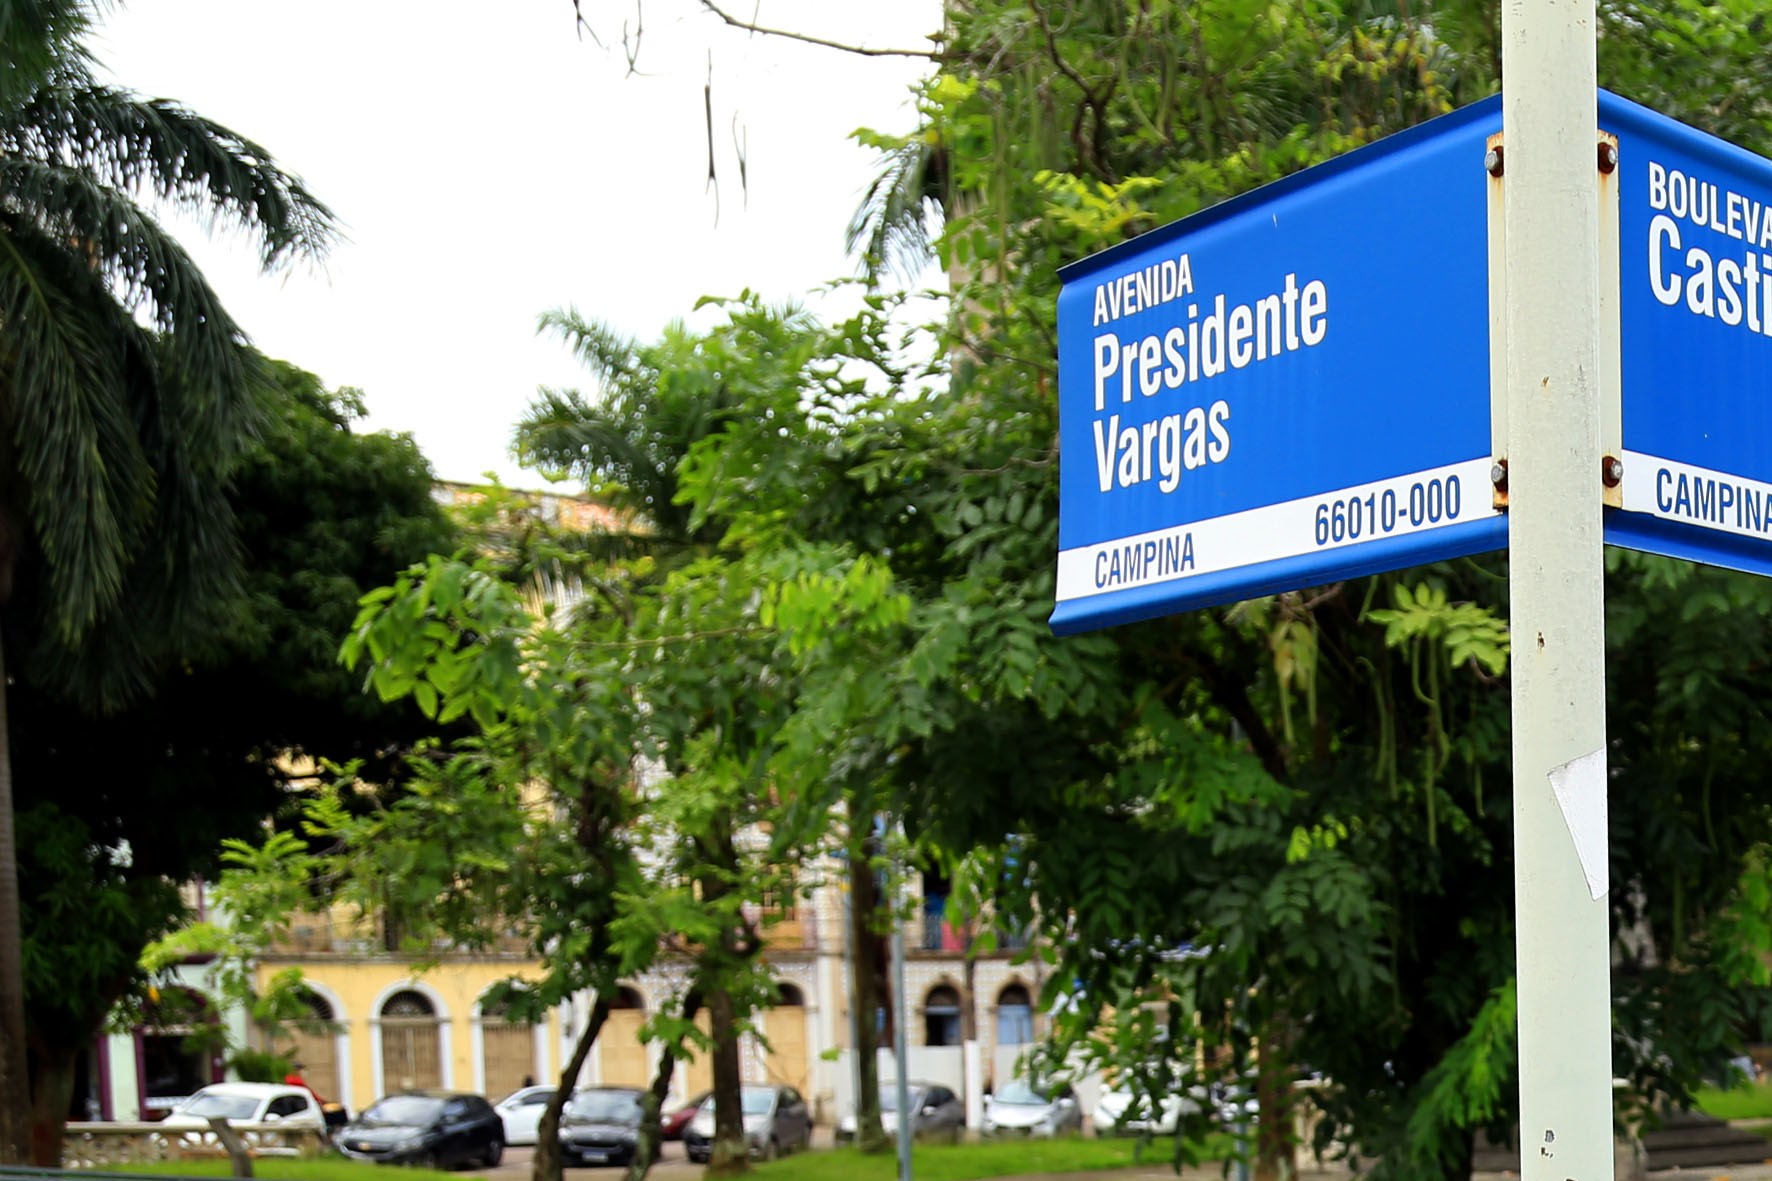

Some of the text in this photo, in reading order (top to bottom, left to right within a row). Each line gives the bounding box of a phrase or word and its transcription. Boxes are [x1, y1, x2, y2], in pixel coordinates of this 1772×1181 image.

[1092, 253, 1194, 327] AVENIDA
[1093, 273, 1328, 410] Presidente
[1093, 399, 1231, 494] Vargas
[1094, 474, 1462, 589] CAMPINA 66010-000
